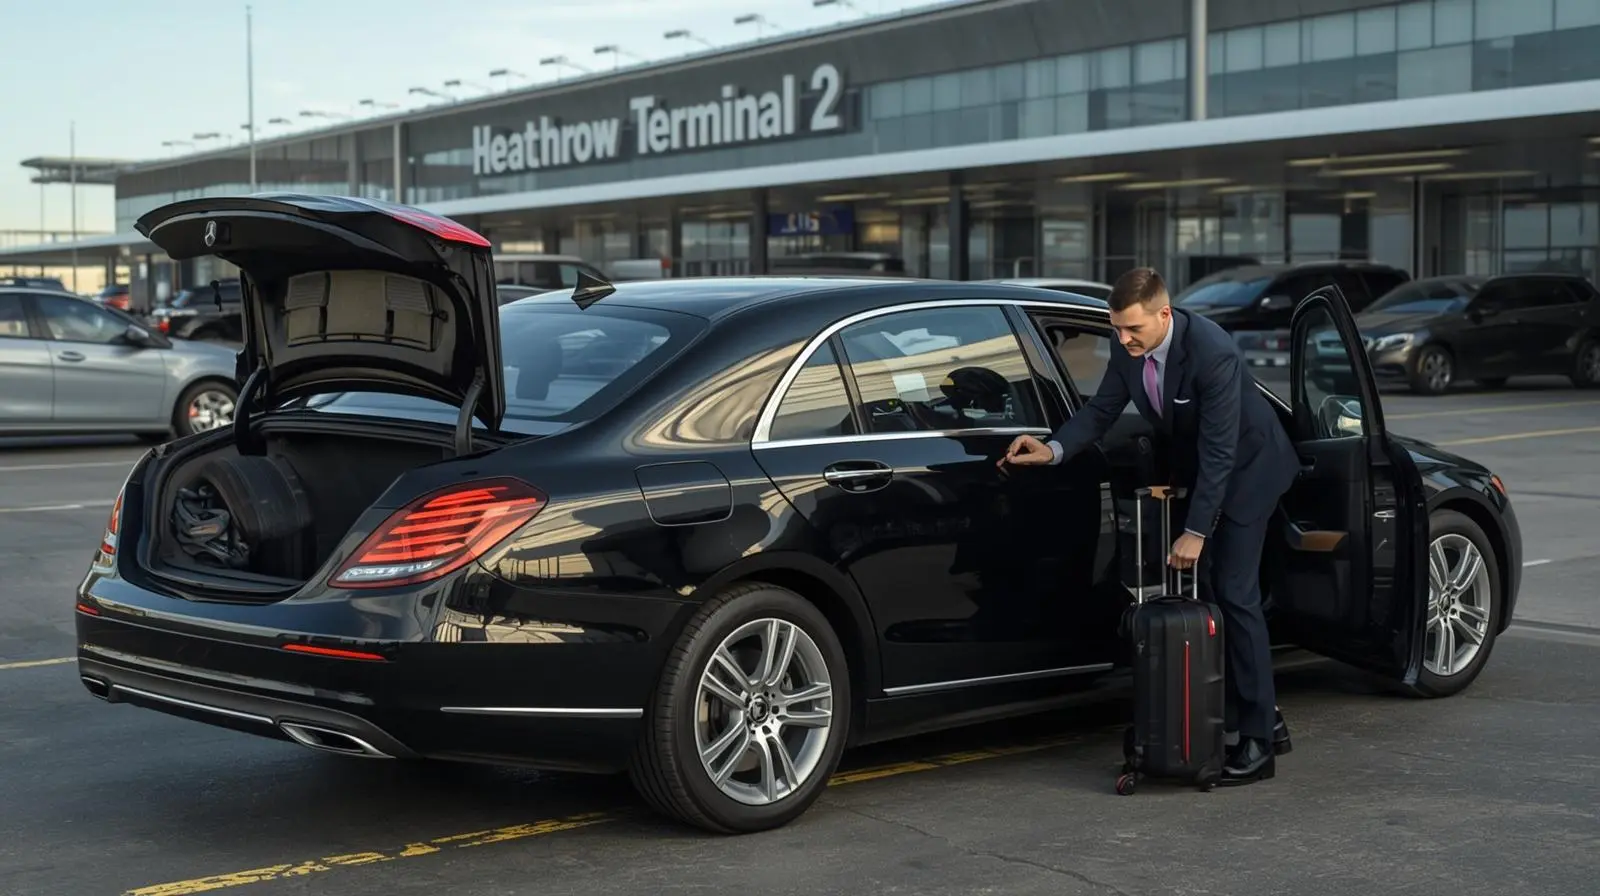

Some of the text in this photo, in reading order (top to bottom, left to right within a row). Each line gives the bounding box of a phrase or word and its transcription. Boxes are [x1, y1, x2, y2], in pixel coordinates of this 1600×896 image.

[473, 63, 841, 175] Heathrow Terminal 2
